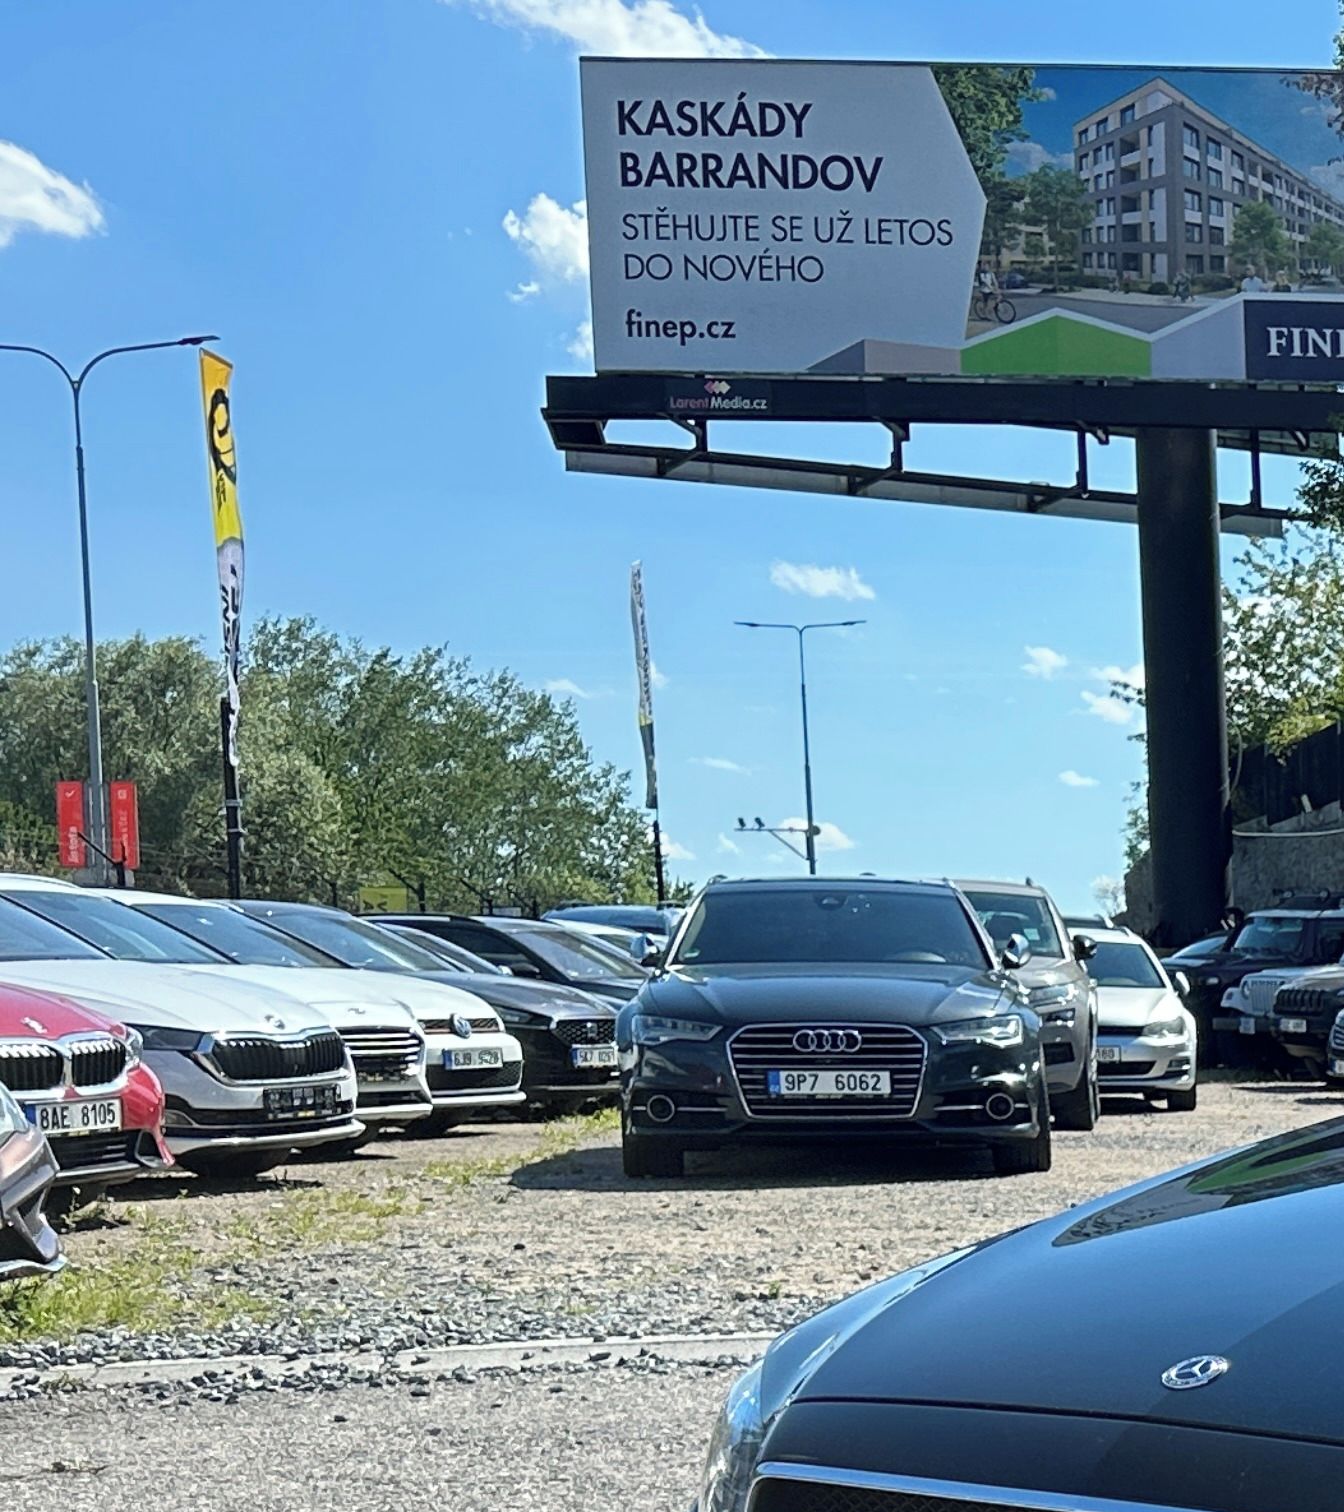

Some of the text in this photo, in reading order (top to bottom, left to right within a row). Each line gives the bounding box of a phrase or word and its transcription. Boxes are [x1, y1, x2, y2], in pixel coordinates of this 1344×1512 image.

[617, 91, 813, 138] KASKÁDY
[619, 152, 883, 194] BARRANDOV
[622, 207, 953, 247] STĚHUJTE SE UŽ LETOS
[623, 248, 825, 283] DO NOVÉHO
[624, 306, 737, 346] finep.cz
[784, 1073, 820, 1092] 9P7
[834, 1073, 882, 1092] 6062
[40, 1102, 116, 1129] 8AE 8105
